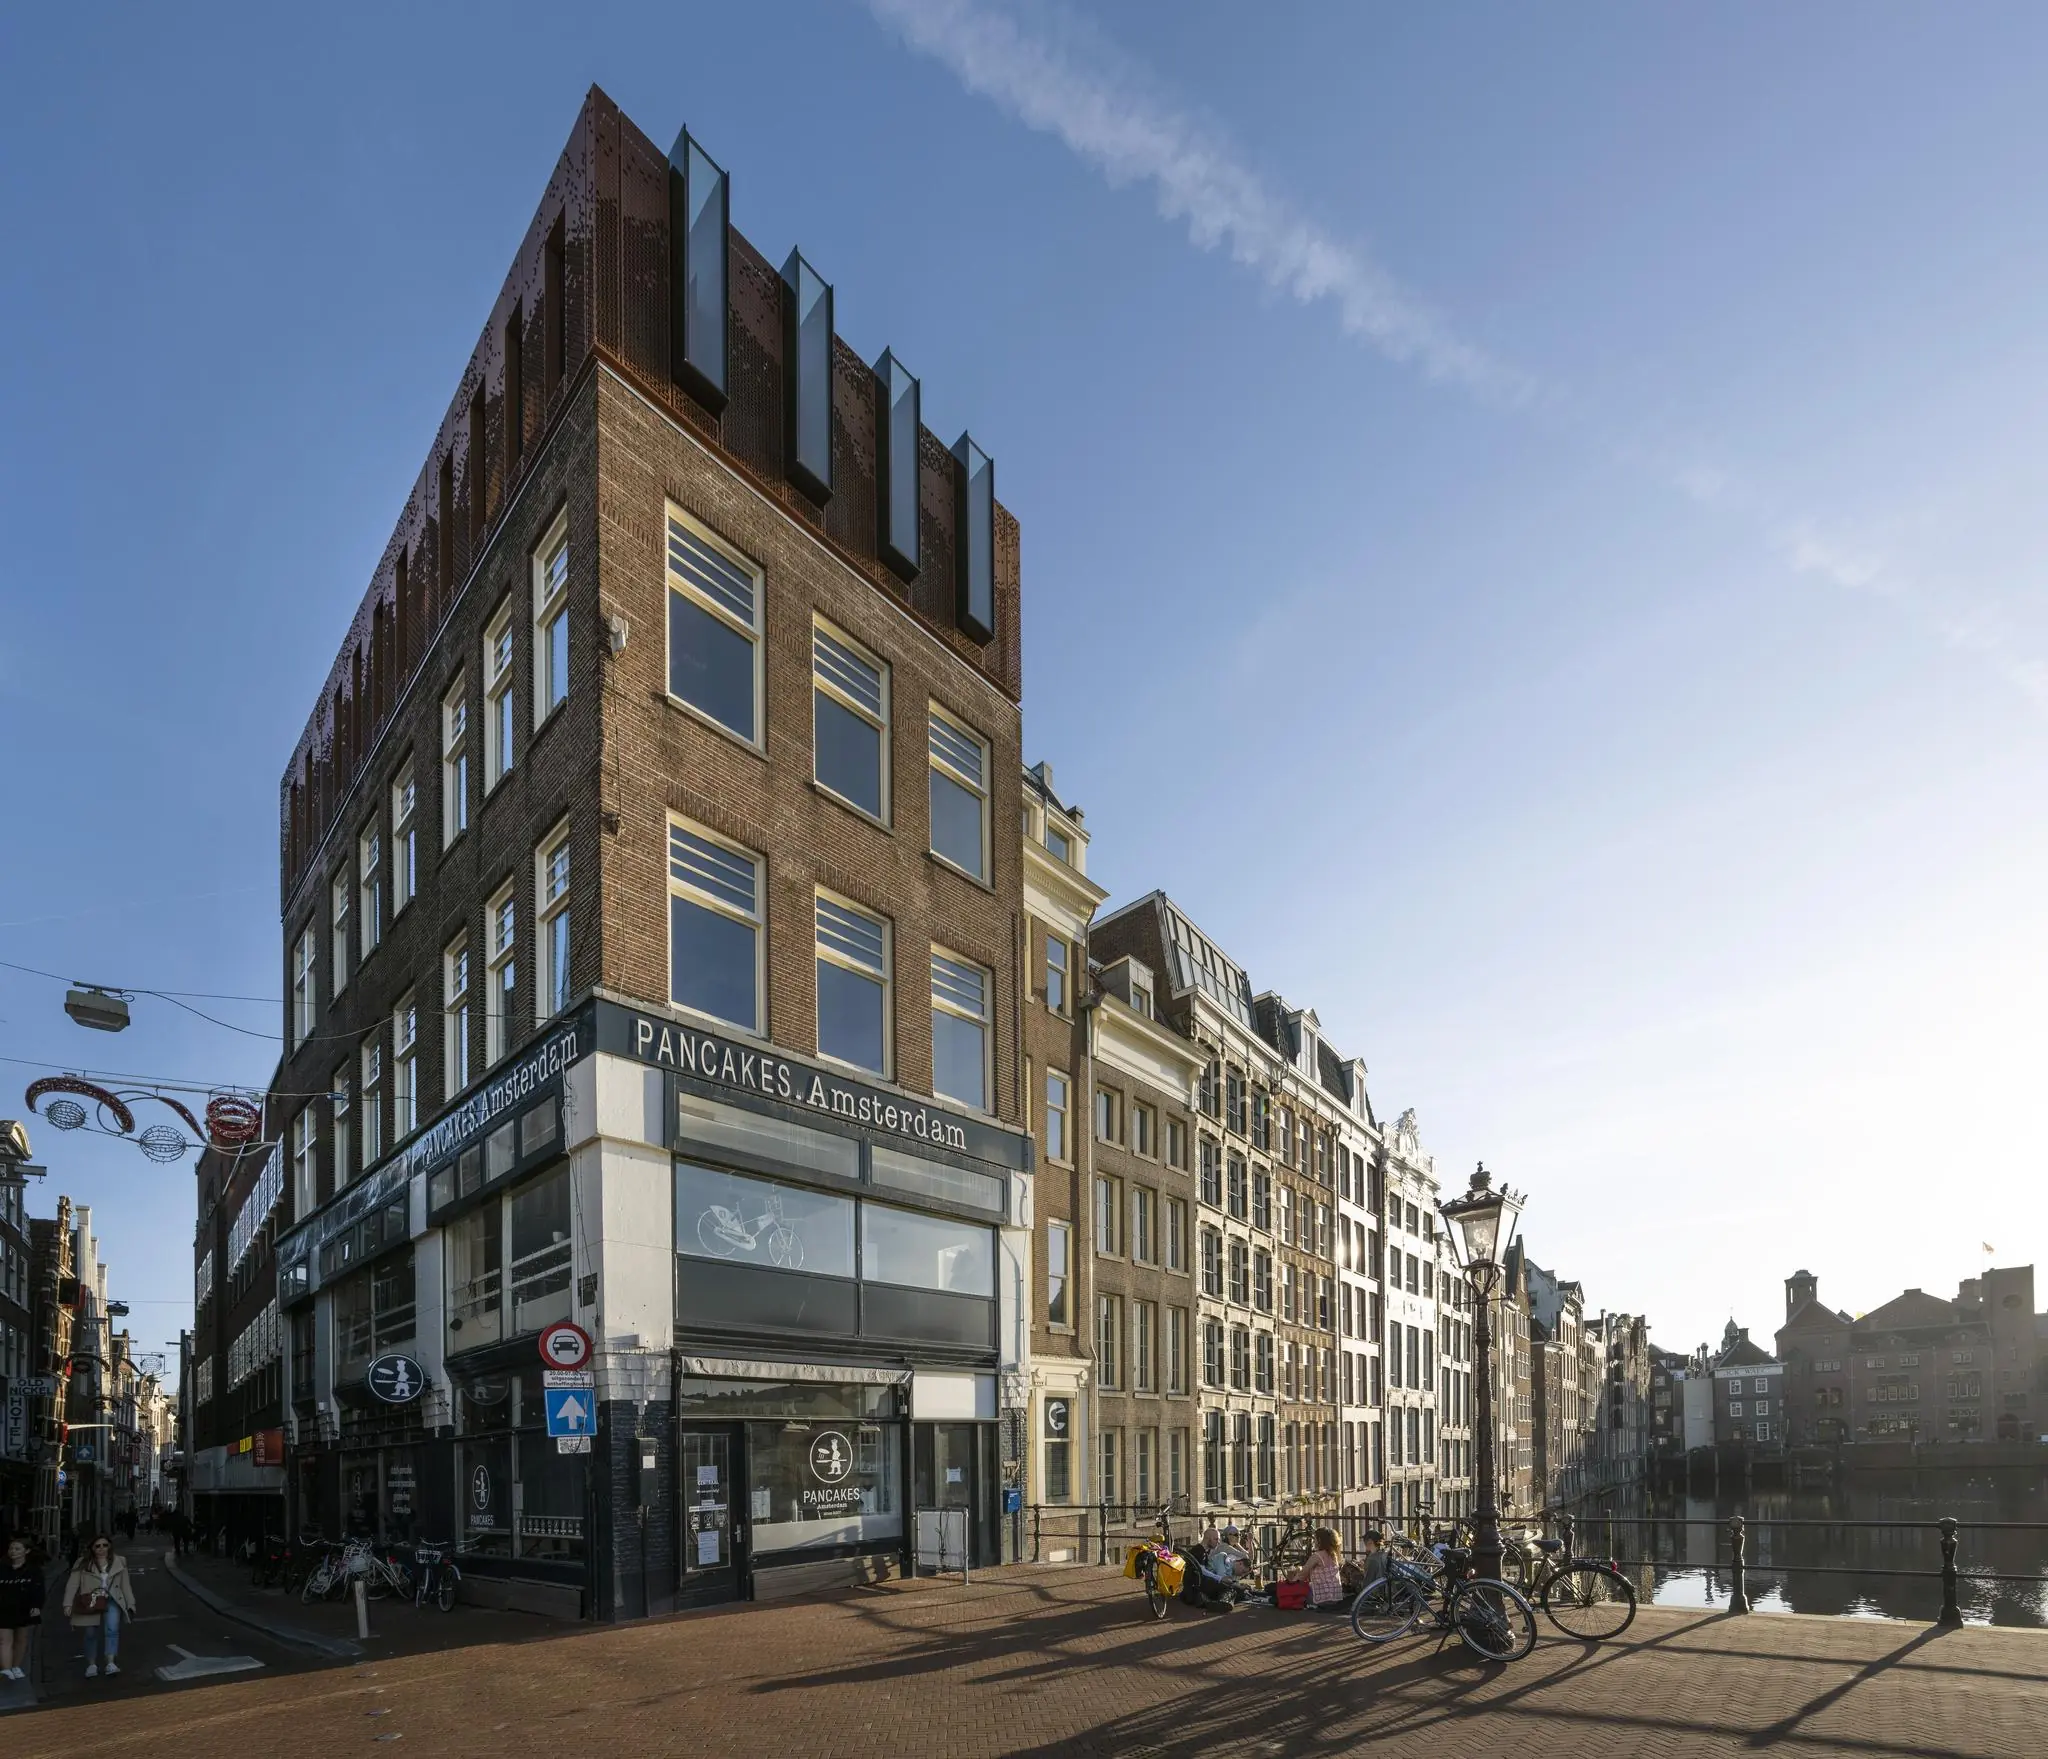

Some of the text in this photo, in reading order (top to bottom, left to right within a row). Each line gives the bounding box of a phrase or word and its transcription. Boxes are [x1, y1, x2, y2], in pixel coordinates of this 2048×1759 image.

[480, 1031, 579, 1126] Amsterdam
[807, 1076, 967, 1151] Amsterdam
[17, 1379, 44, 1387] OLD
[10, 1386, 53, 1396] NICKEL
[10, 1397, 22, 1446] HOTEL
[803, 1488, 860, 1503] PANCAKES
[817, 1502, 847, 1510] Amsterdam
